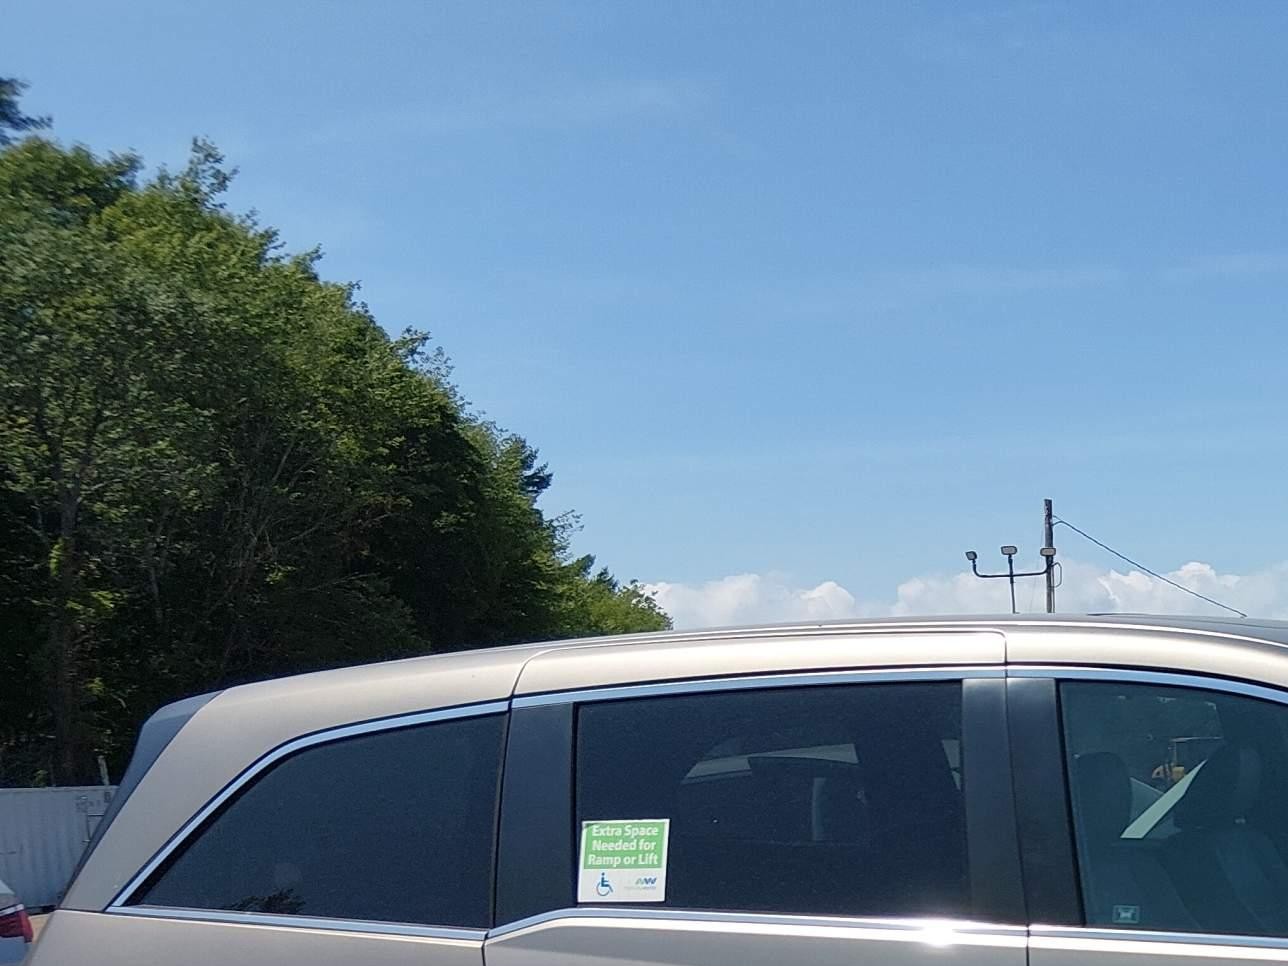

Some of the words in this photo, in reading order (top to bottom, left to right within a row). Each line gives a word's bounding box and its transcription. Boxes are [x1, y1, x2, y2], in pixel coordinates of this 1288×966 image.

[592, 825, 622, 837] Extra
[624, 825, 659, 838] Space
[592, 840, 637, 851] Needed
[639, 839, 657, 850] for
[588, 854, 621, 868] Ramp
[623, 856, 637, 865] or
[639, 853, 659, 865] Lift
